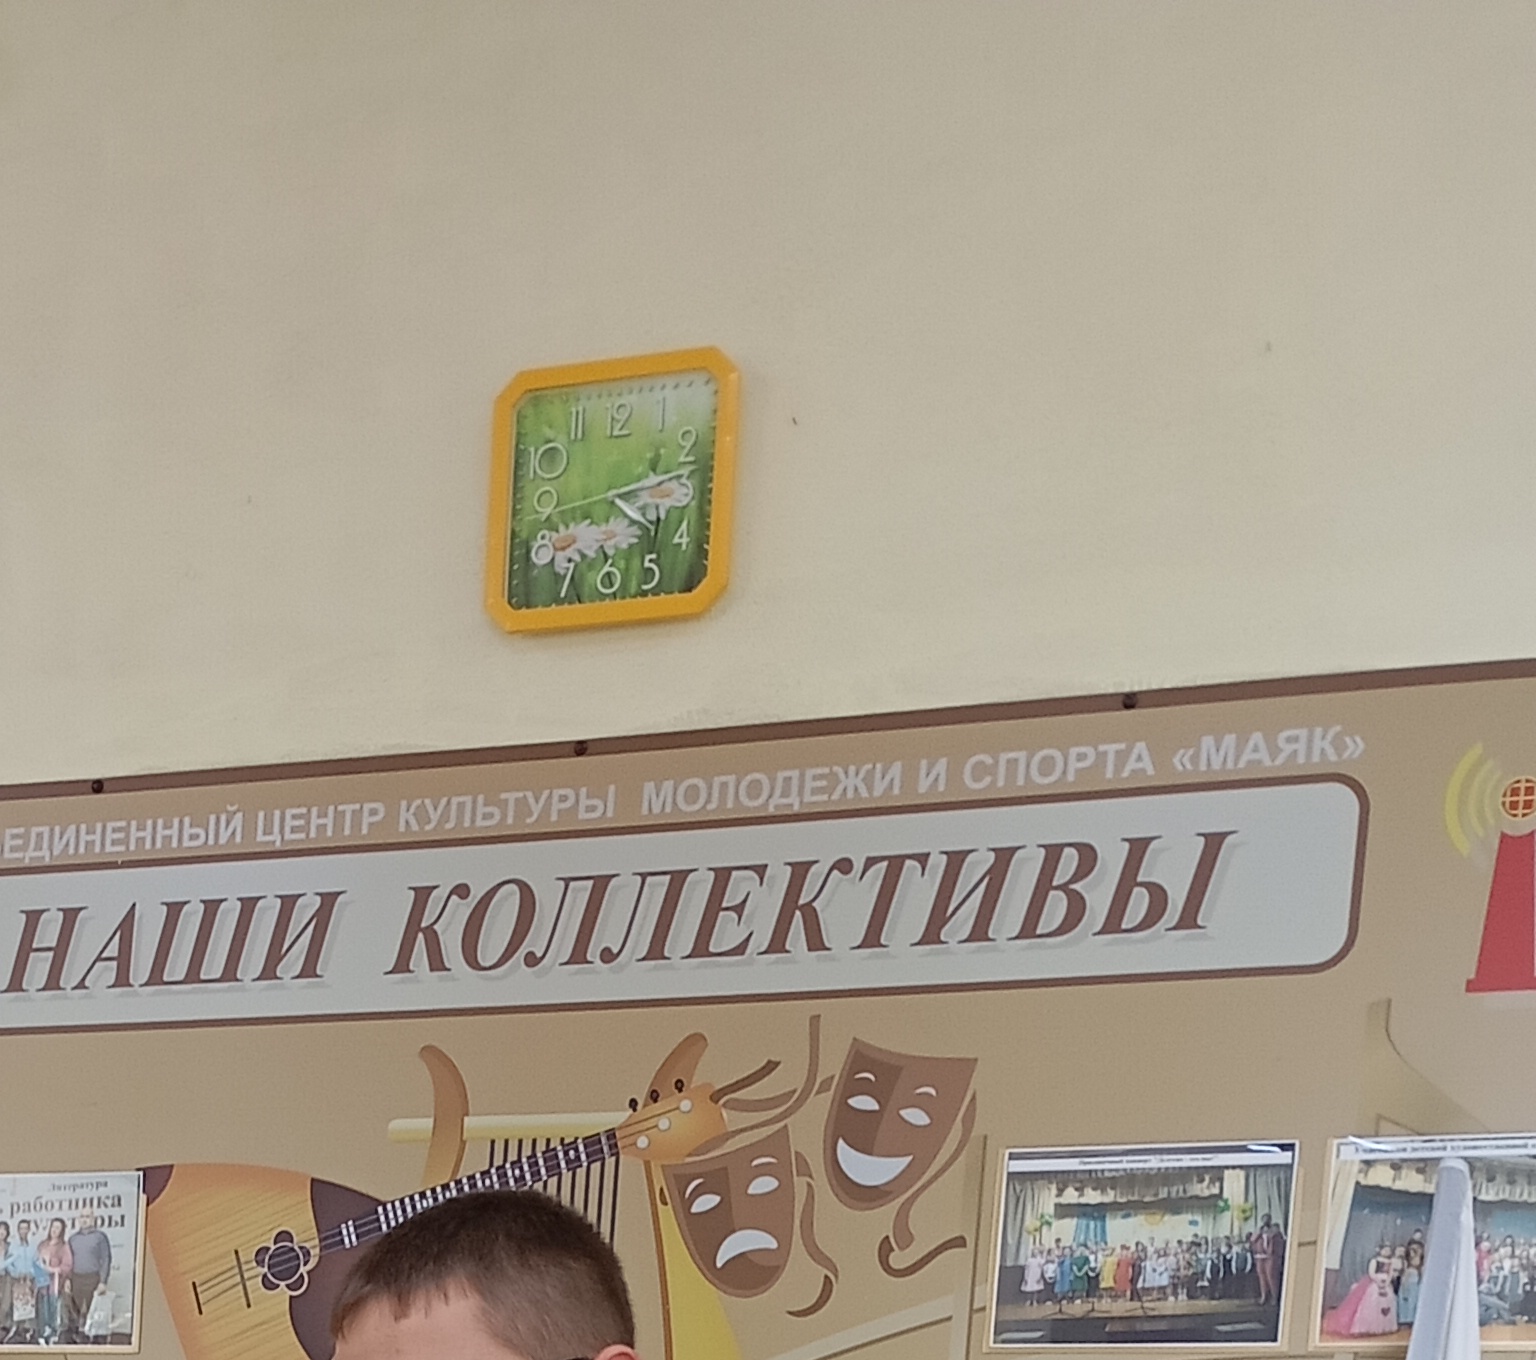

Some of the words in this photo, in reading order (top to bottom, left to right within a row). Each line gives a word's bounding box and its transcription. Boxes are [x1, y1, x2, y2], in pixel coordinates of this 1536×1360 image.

[605, 401, 633, 438] 12
[528, 441, 569, 481] 10
[677, 426, 699, 464] 2
[533, 486, 559, 523] 9
[671, 517, 691, 551] 4
[596, 558, 622, 595] 6
[641, 553, 661, 591] 5
[255, 801, 386, 846] ЦЕНТР
[398, 783, 618, 832] КУЛЬТУРЫ
[640, 760, 903, 816] МОЛОДЕЖИ
[917, 757, 948, 793] И
[962, 740, 1156, 792] СПОРТА
[1172, 725, 1367, 774] «МАЯК»
[0, 888, 348, 994] НАШИ
[383, 829, 1241, 976] КОЛЛЕКТИВЫ
[9, 1193, 123, 1220] работника
